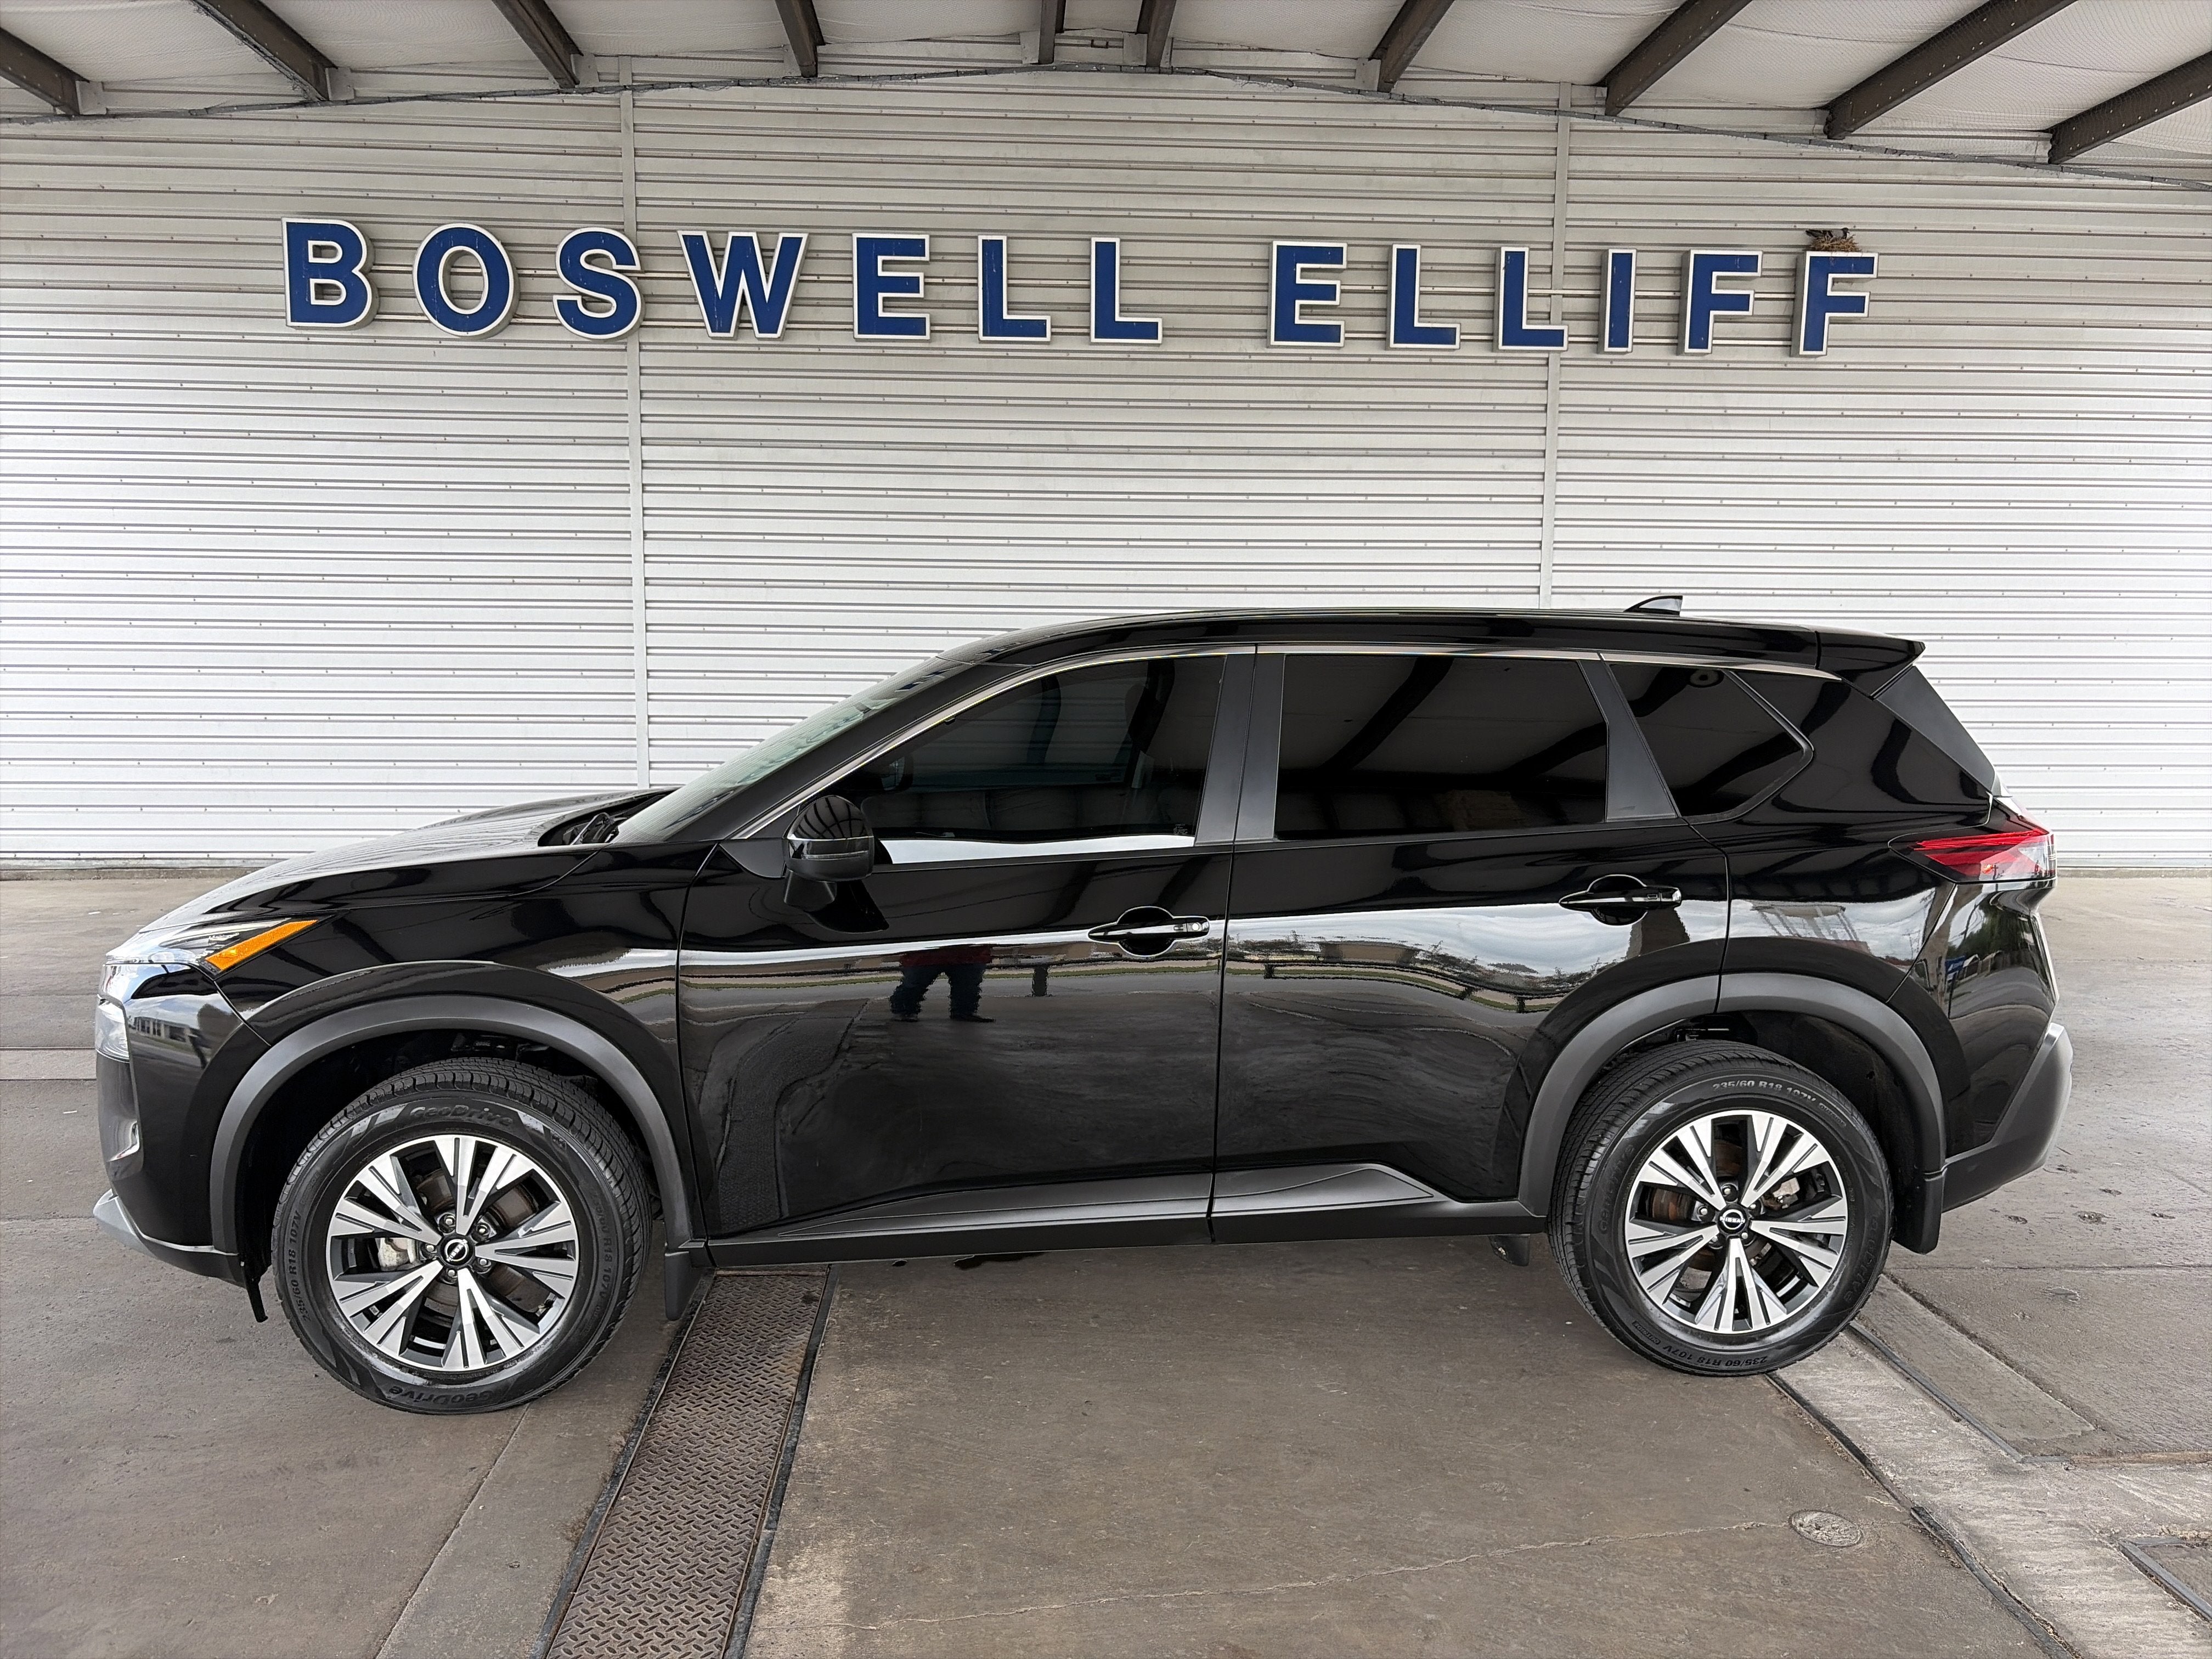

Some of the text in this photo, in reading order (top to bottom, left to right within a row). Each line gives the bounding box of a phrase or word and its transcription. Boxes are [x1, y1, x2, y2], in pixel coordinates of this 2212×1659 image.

[281, 217, 1878, 356] BOSWELL ELLIFF
[1712, 1080, 1755, 1092] 235/60
[1758, 1080, 1783, 1092] R18
[1786, 1086, 1817, 1103] 107V
[410, 1104, 514, 1126] GeoDrive
[289, 1210, 302, 1245] 107V
[1719, 1216, 1746, 1224] NISSAN
[446, 1239, 469, 1262] NISSAN
[603, 1237, 613, 1262] R18
[288, 1249, 298, 1276] R18
[291, 1280, 312, 1323] 235/60
[1662, 1344, 1693, 1361] 107V
[1696, 1356, 1722, 1367] R18
[1725, 1355, 1768, 1367] 235/60
[388, 1385, 494, 1406] GeoDrive
